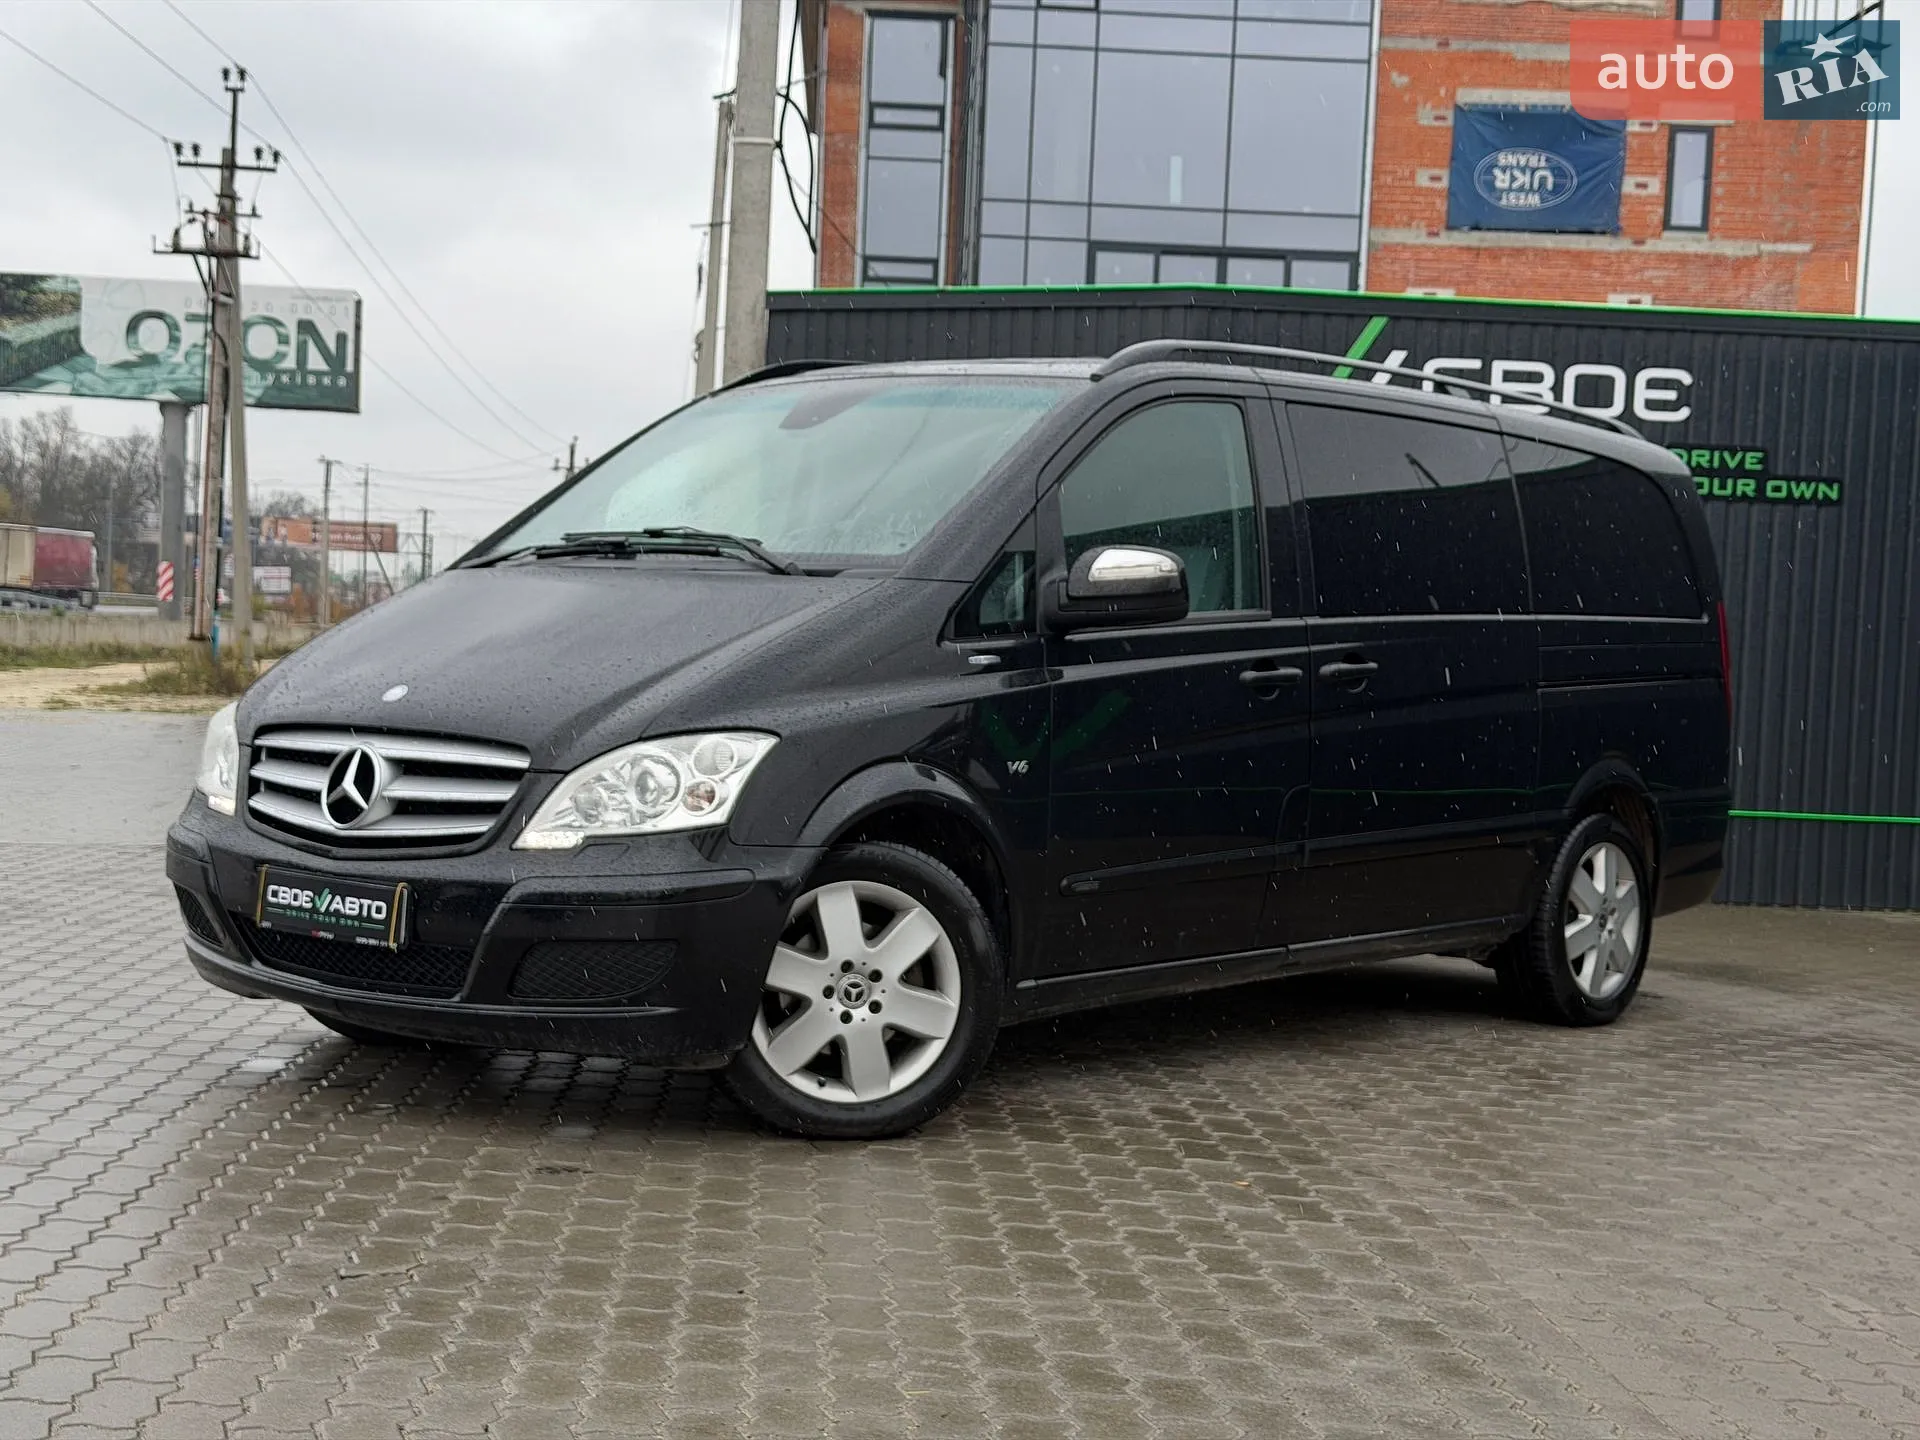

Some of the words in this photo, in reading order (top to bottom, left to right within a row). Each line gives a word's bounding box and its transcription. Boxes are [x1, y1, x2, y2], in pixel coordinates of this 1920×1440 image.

[1497, 151, 1548, 168] TRANS
[1492, 167, 1554, 191] UKR
[1500, 191, 1541, 208] WEST
[1693, 476, 1757, 498] OUR
[1766, 480, 1840, 500] OWN
[1006, 759, 1030, 775] V6
